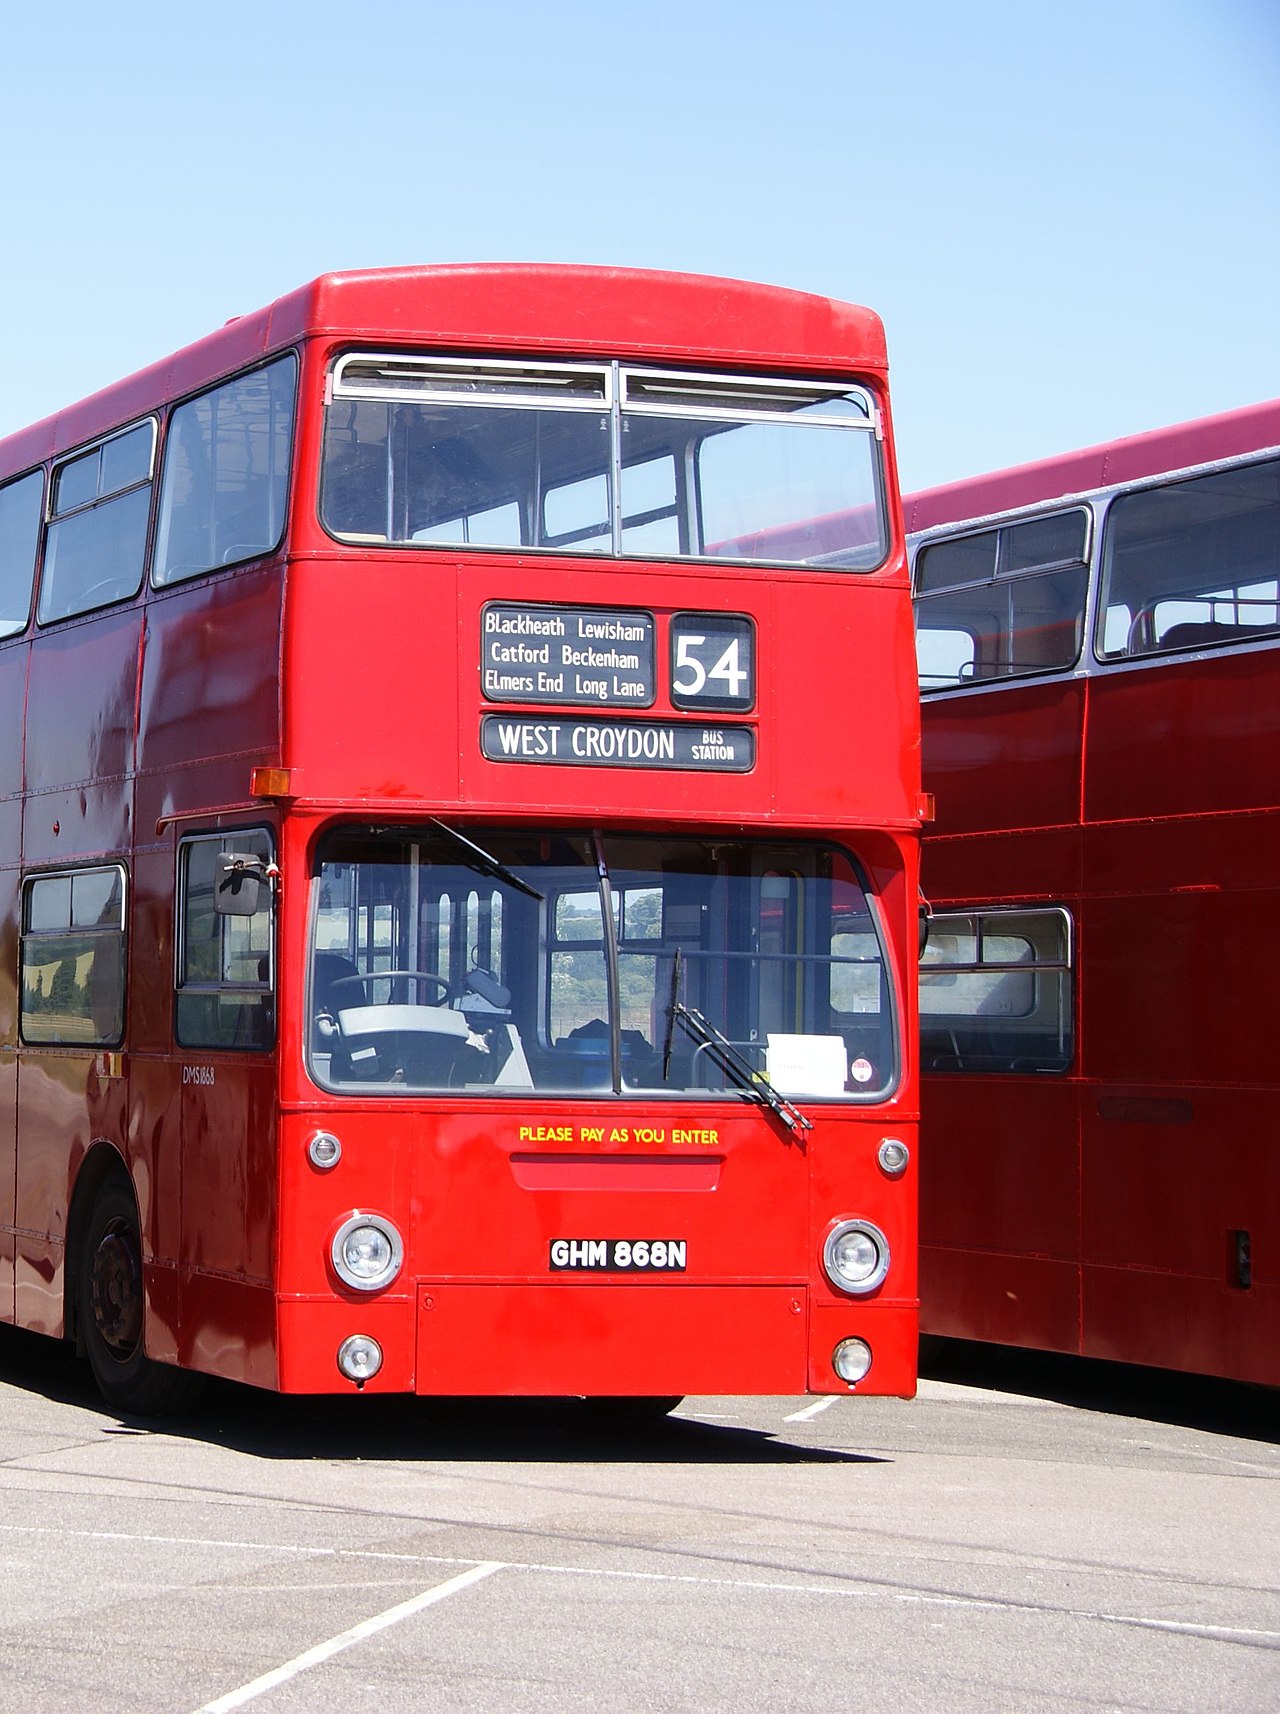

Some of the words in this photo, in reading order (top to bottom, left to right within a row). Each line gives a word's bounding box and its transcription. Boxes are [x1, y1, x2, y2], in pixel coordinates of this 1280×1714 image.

[486, 613, 565, 636] Blackheath
[578, 618, 644, 641] Lewisham
[491, 642, 549, 664] Catford
[562, 647, 639, 669] Beckenham
[673, 636, 747, 695] 54
[485, 670, 533, 692] Elmers
[537, 672, 563, 693] End
[576, 674, 608, 700] Long
[613, 676, 645, 697] Lane
[498, 724, 560, 755] WEST
[572, 726, 674, 759] CROYDON
[702, 731, 723, 744] BUS
[691, 745, 734, 760] STATION
[183, 1066, 215, 1085] DMS1868
[520, 1127, 573, 1141] PLEASE
[581, 1128, 604, 1142] PAY
[610, 1129, 629, 1142] AS
[633, 1129, 664, 1143] YOU
[672, 1130, 718, 1144] ENTER
[551, 1240, 607, 1266] GHM
[614, 1241, 686, 1267] 868N
